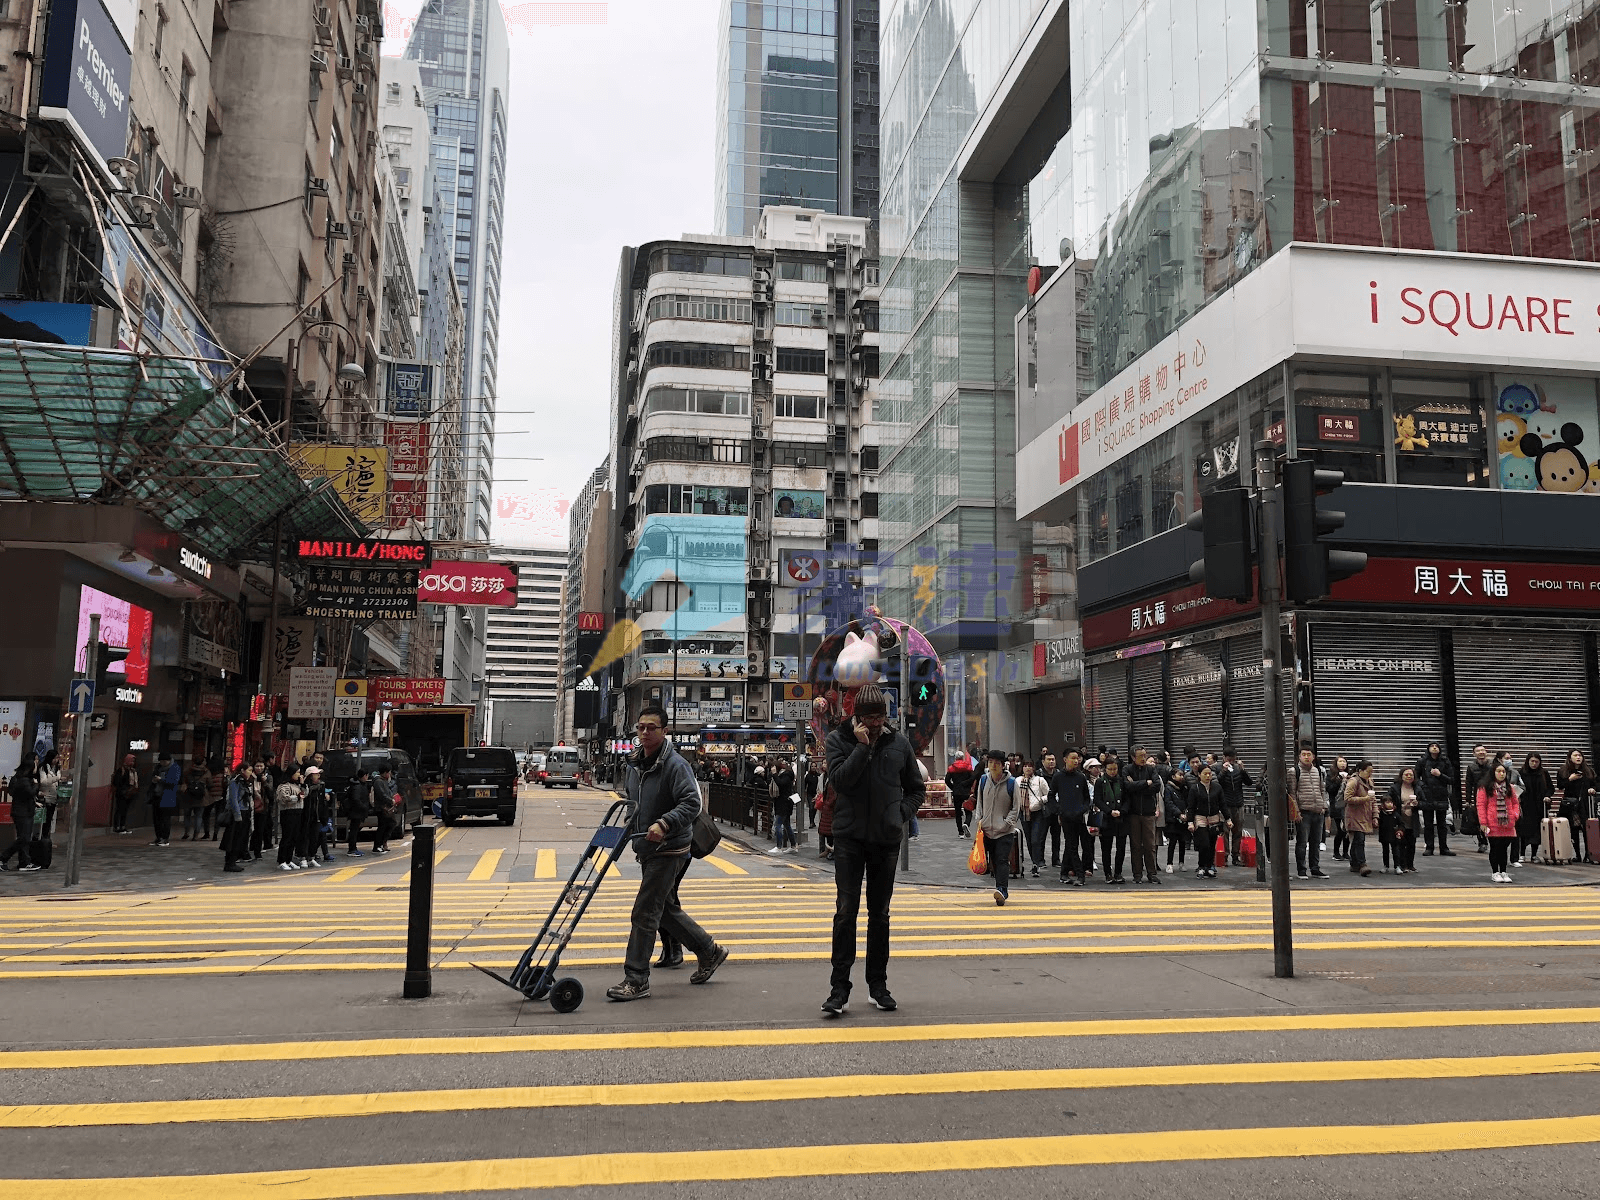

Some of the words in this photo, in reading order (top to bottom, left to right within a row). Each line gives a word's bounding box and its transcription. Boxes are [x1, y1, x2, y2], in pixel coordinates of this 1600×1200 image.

[80, 18, 124, 112] Premier
[1369, 280, 1378, 323] i
[1401, 287, 1575, 337] SQUARE
[1081, 339, 1206, 445] 國際廣場購物中心
[1103, 418, 1136, 452] SQUARE
[1139, 399, 1175, 431] Shopping
[1177, 378, 1208, 405] Centre
[1324, 418, 1354, 430] 周大福
[1418, 420, 1447, 432] 周大福
[1450, 422, 1479, 433] 迪士尼
[299, 540, 426, 560] MANILA/HONG
[180, 547, 208, 578] swatch
[471, 576, 505, 593] 莎莎
[1413, 565, 1509, 597] 周大福
[1529, 579, 1562, 590] CHOW
[1565, 580, 1585, 590] TAI
[320, 584, 339, 593] MAN
[342, 585, 366, 594] WING
[368, 587, 394, 595] CHUN
[363, 598, 409, 606] 27232306
[306, 606, 374, 618] SHOESTRING
[378, 610, 418, 619] TRAVEL
[1131, 601, 1166, 631] 周大福
[1051, 636, 1080, 660] SQUARE
[1314, 658, 1374, 671] HEARTS
[1377, 659, 1399, 671] ON
[1401, 659, 1433, 672] FIRE
[378, 680, 407, 689] TOURS
[411, 680, 444, 689] TICKETS
[576, 683, 600, 691] adidas
[115, 687, 138, 702] swatch
[378, 691, 413, 700] CHINA
[417, 691, 442, 701] VISA
[340, 707, 360, 716] 全日
[789, 709, 808, 718] 全日
